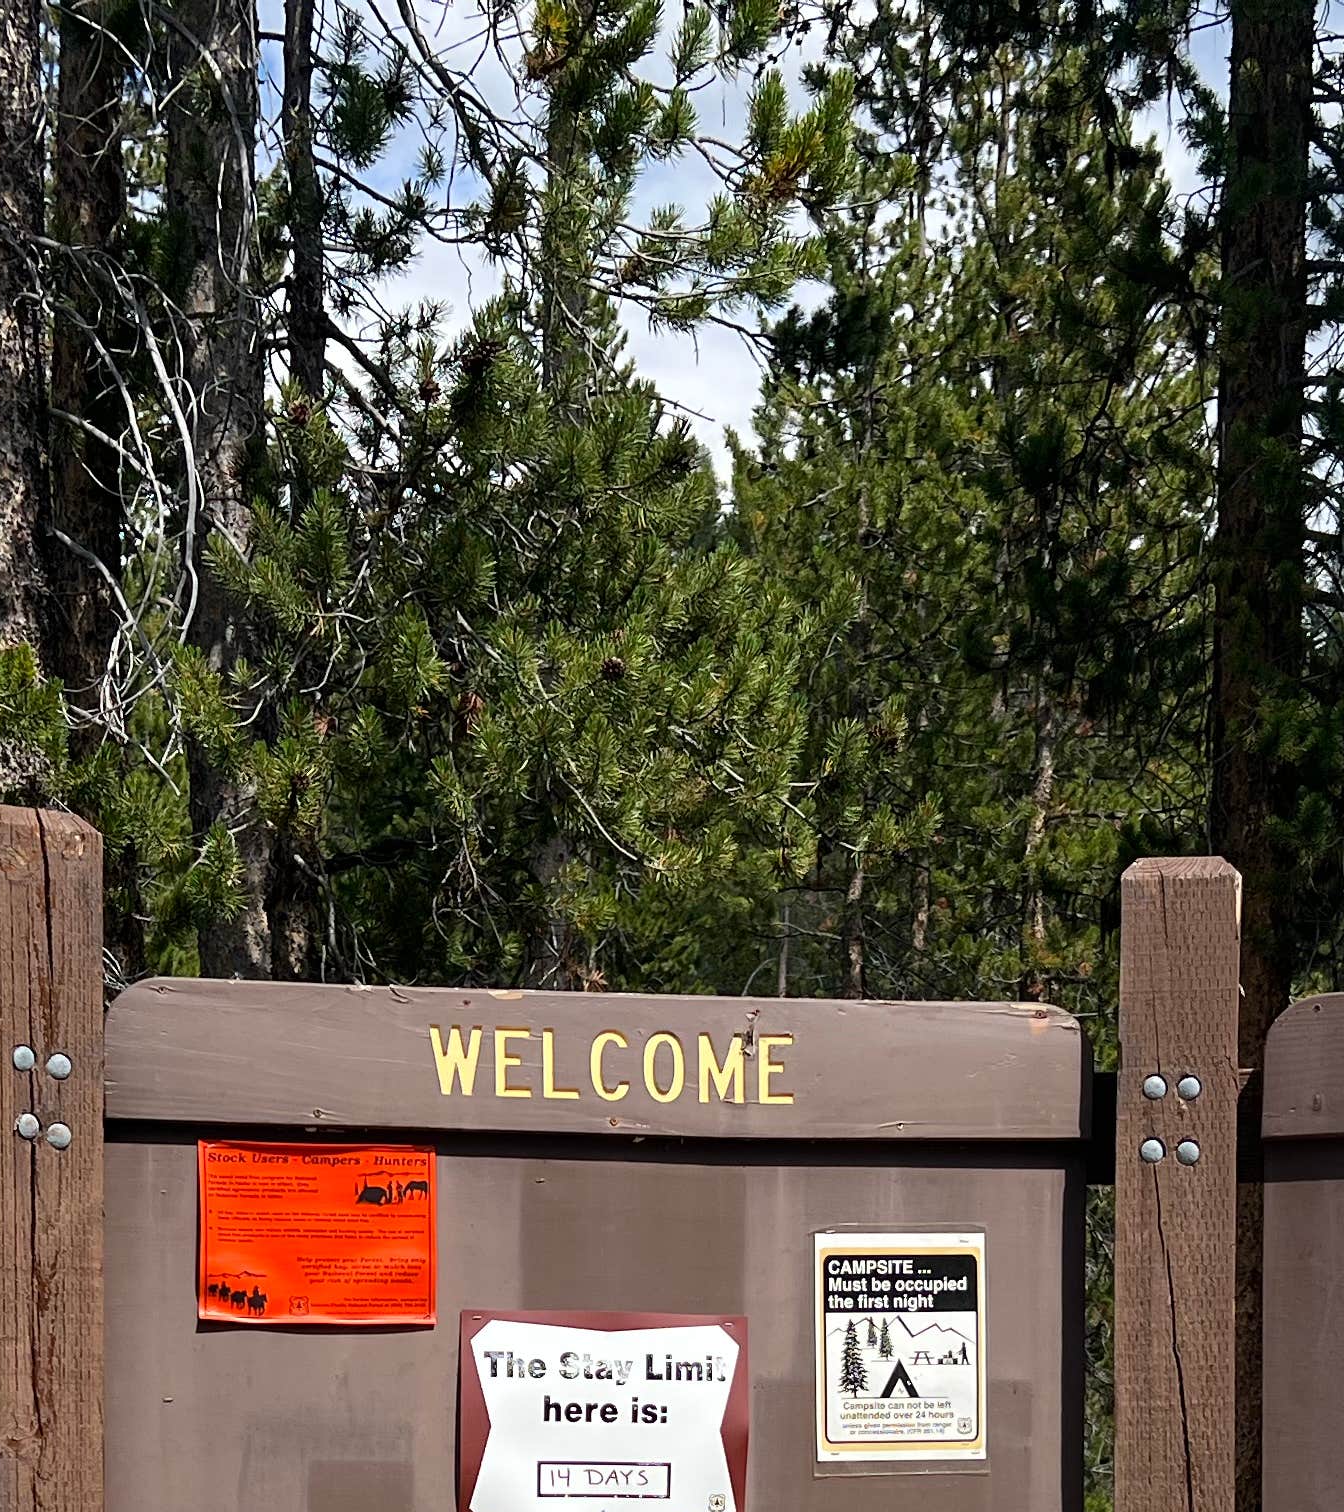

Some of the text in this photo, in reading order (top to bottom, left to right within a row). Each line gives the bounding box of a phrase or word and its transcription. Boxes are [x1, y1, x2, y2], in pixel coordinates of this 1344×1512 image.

[429, 1024, 794, 1105] WELCOME
[208, 1152, 427, 1167] Stock Users Campers Hunters
[828, 1260, 914, 1275] CAMPSITE
[828, 1277, 967, 1294] Must be occupied
[828, 1294, 934, 1311] the first night
[484, 1351, 726, 1386] The Stay Limit
[544, 1395, 668, 1424] here is:
[551, 1468, 648, 1487] 14 DAYS
